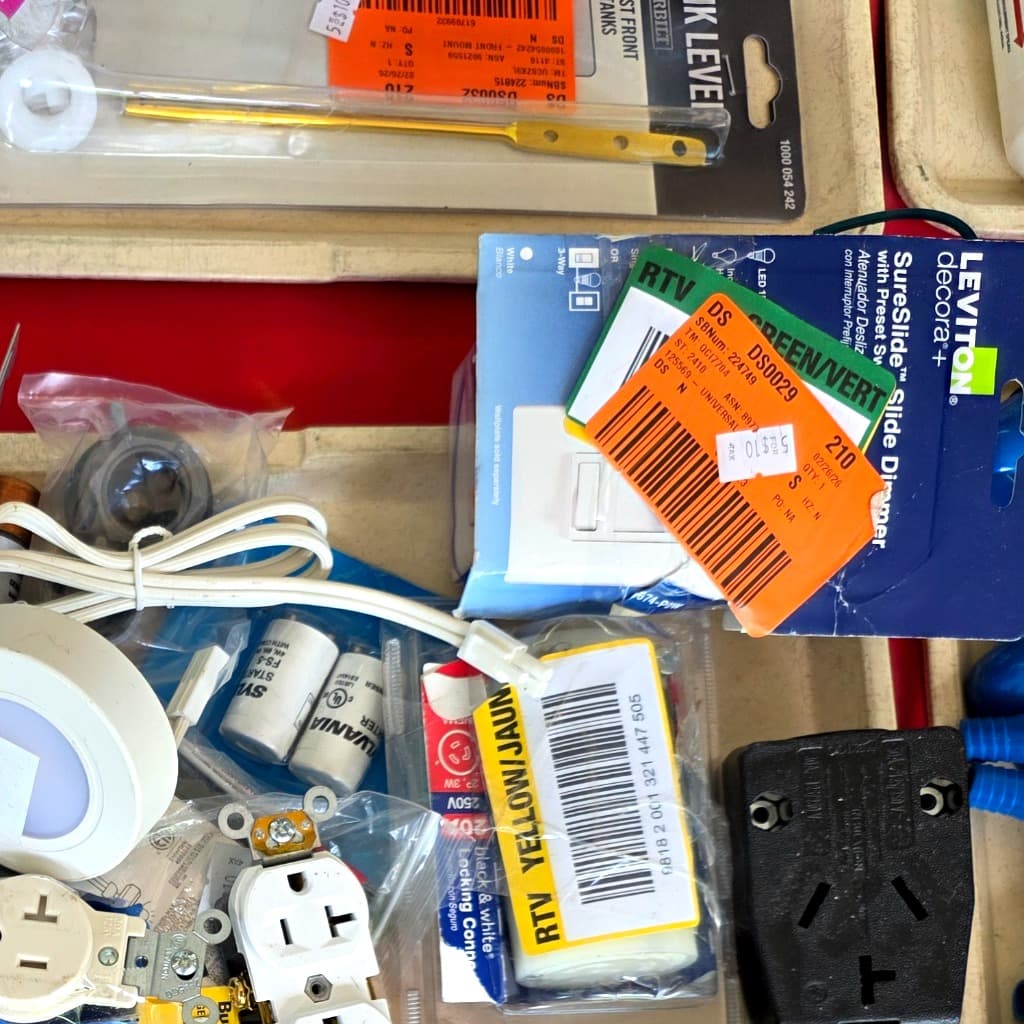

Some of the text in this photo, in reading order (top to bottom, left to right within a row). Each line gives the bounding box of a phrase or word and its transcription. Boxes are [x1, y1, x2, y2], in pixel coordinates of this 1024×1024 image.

[404, 43, 414, 56] S
[530, 34, 538, 43] N
[621, 17, 639, 61] FRONT
[780, 139, 796, 210] 1000 054 242
[506, 247, 515, 274] White
[556, 247, 566, 276] 3-Way
[609, 248, 619, 263] OR
[844, 249, 853, 267] con
[638, 260, 697, 303] RTV
[758, 268, 767, 288] LED
[856, 249, 871, 315] Atenuador
[842, 270, 855, 319] Interruptor
[875, 249, 890, 341] with Preset
[949, 251, 984, 395] LEVITON
[654, 357, 687, 394] DS N
[665, 350, 692, 379] 125569
[727, 351, 758, 386] 224749
[707, 300, 856, 471] DS DS0029 210
[885, 389, 905, 448] Slide
[780, 435, 789, 453] 5
[789, 475, 802, 490] S
[629, 694, 645, 722] 505
[638, 727, 651, 754] 447
[444, 779, 461, 789] 3W
[642, 760, 660, 788] 321
[447, 796, 480, 810] 250V
[648, 793, 666, 821] 001
[653, 823, 666, 834] 2
[459, 848, 473, 913] Locking
[474, 846, 496, 953] black & white
[527, 892, 560, 945] RTV
